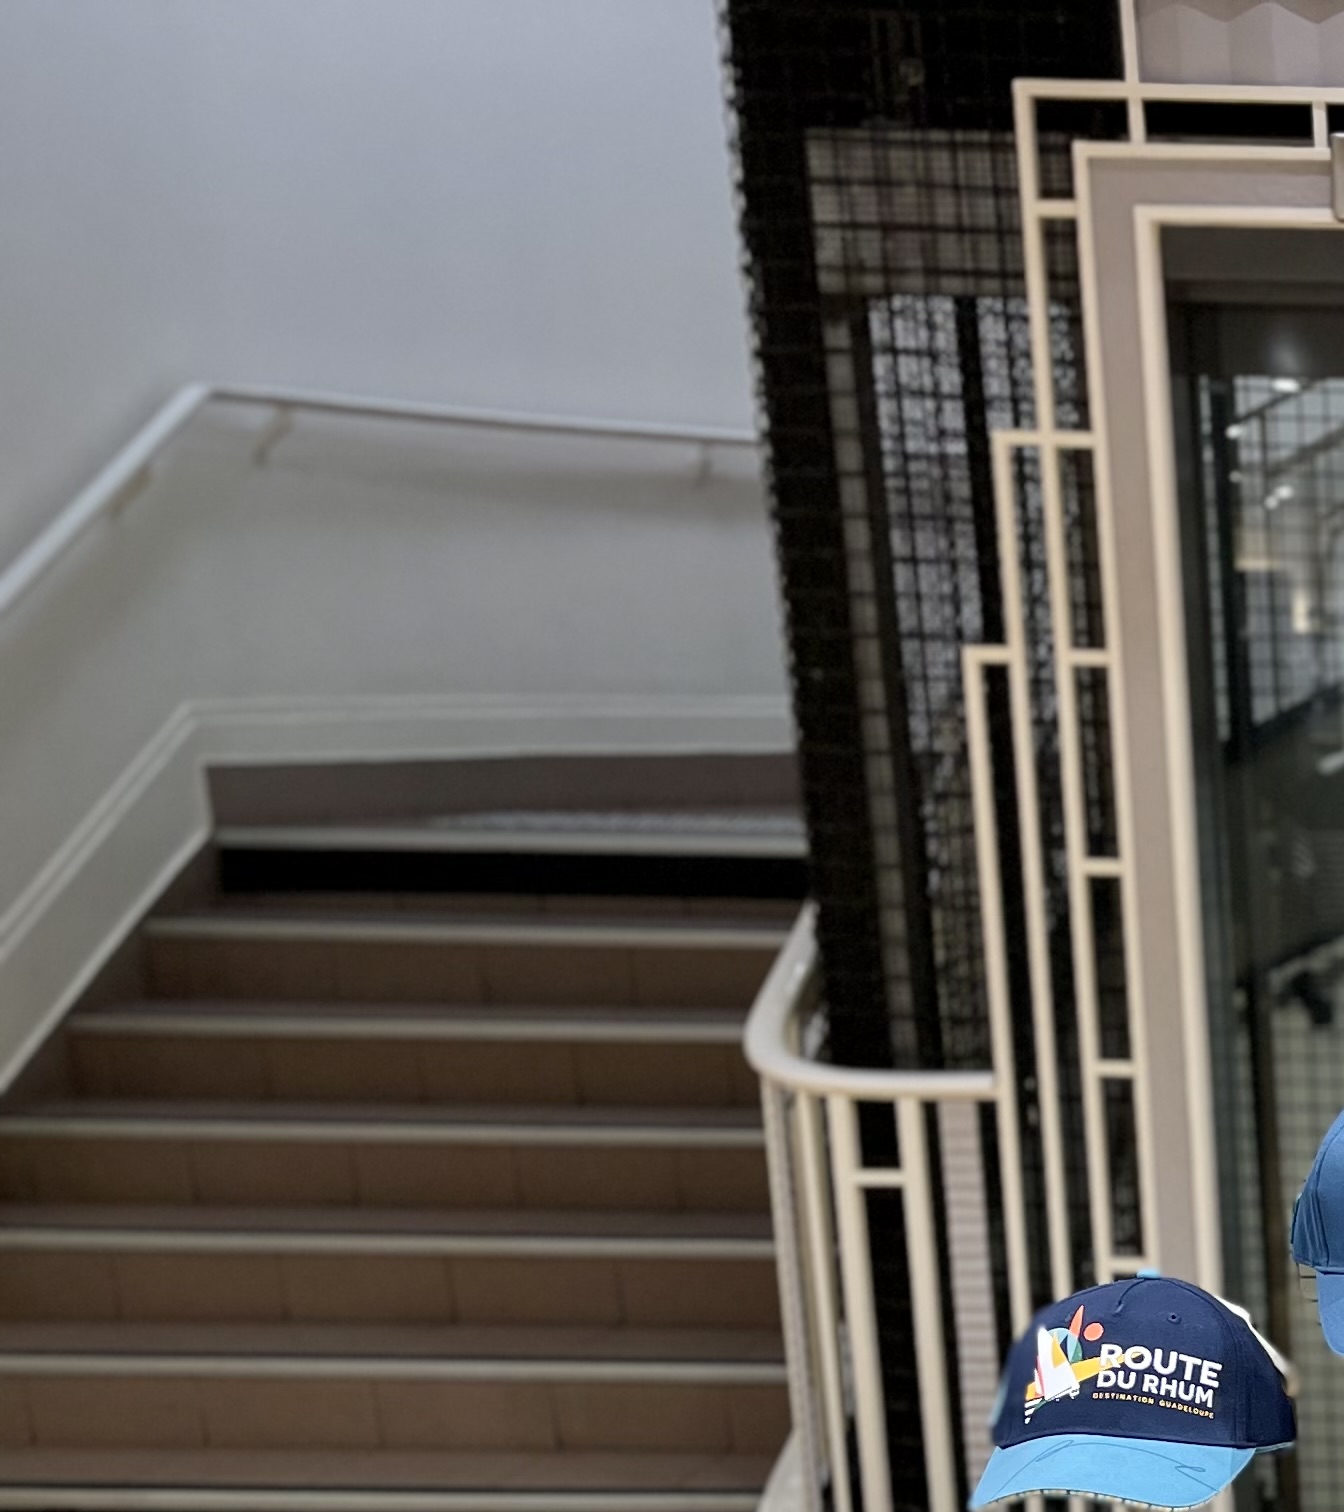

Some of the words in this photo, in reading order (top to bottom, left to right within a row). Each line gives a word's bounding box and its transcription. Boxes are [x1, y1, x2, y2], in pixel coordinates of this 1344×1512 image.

[1100, 1343, 1223, 1388] ROUTE
[1092, 1391, 1155, 1405] DESTINATION
[1158, 1399, 1214, 1419] GUADELOUPE
[1097, 1370, 1137, 1389] DU
[1142, 1373, 1214, 1408] RHUM
